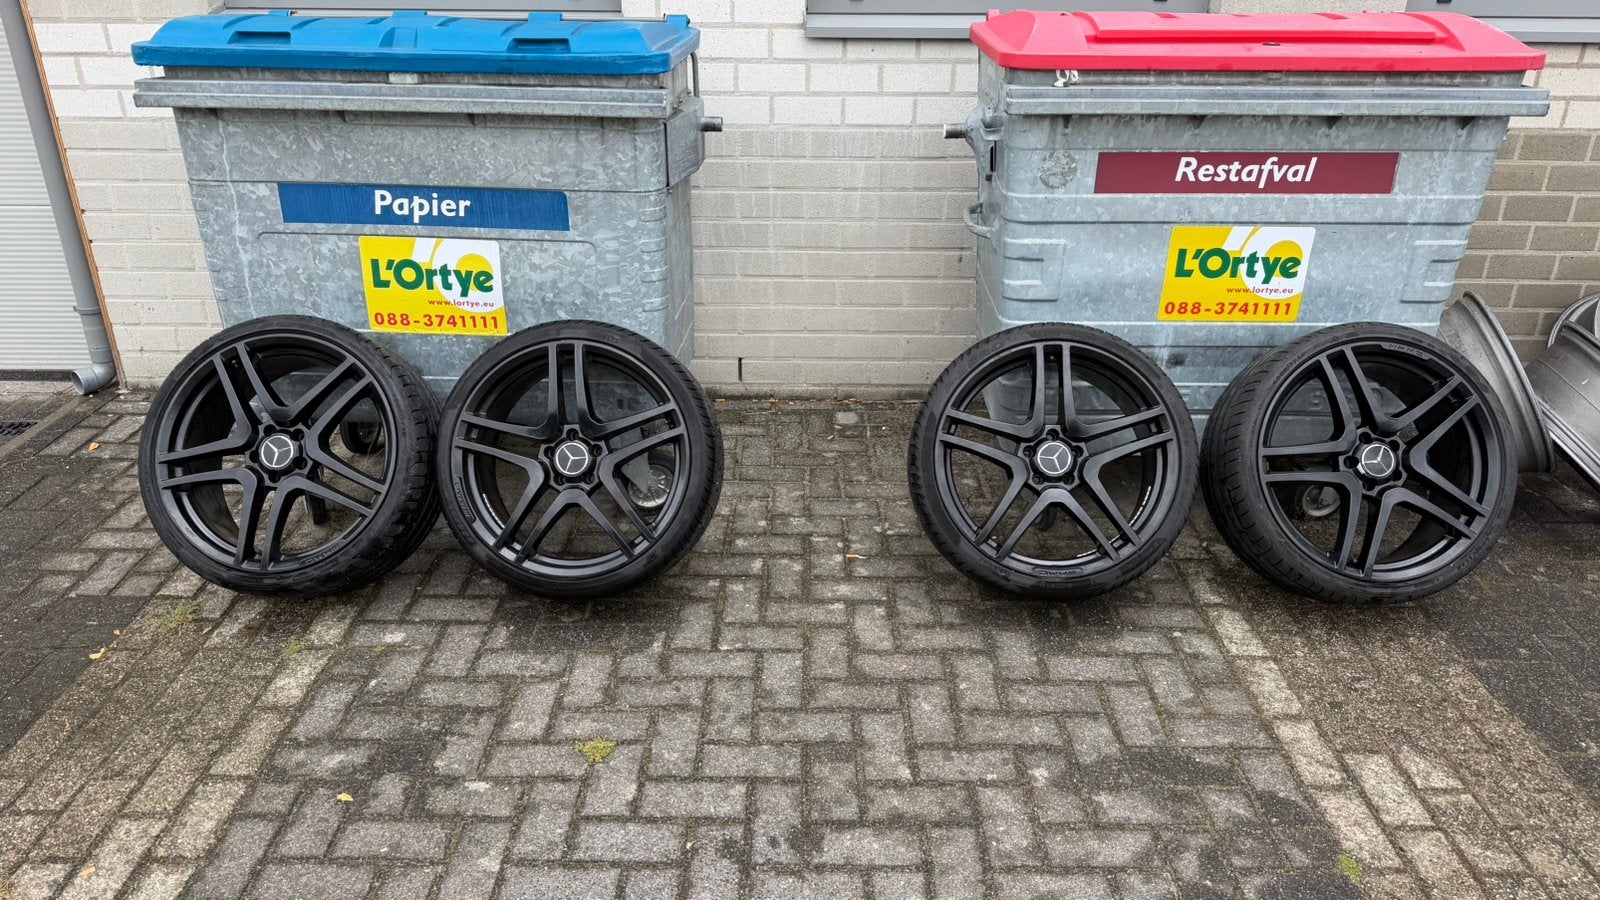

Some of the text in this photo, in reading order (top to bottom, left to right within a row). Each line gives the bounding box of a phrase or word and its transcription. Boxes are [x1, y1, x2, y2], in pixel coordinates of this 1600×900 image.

[1174, 156, 1318, 189] Restafval
[374, 189, 471, 224] Papier
[371, 259, 495, 298] L'Ortye
[1175, 248, 1302, 285] L'Ortye
[1227, 286, 1294, 295] www.lortye.eu
[428, 299, 494, 308] www.lortye.eu
[1164, 302, 1291, 315] 088-3741111
[374, 312, 498, 329] 088-3741111
